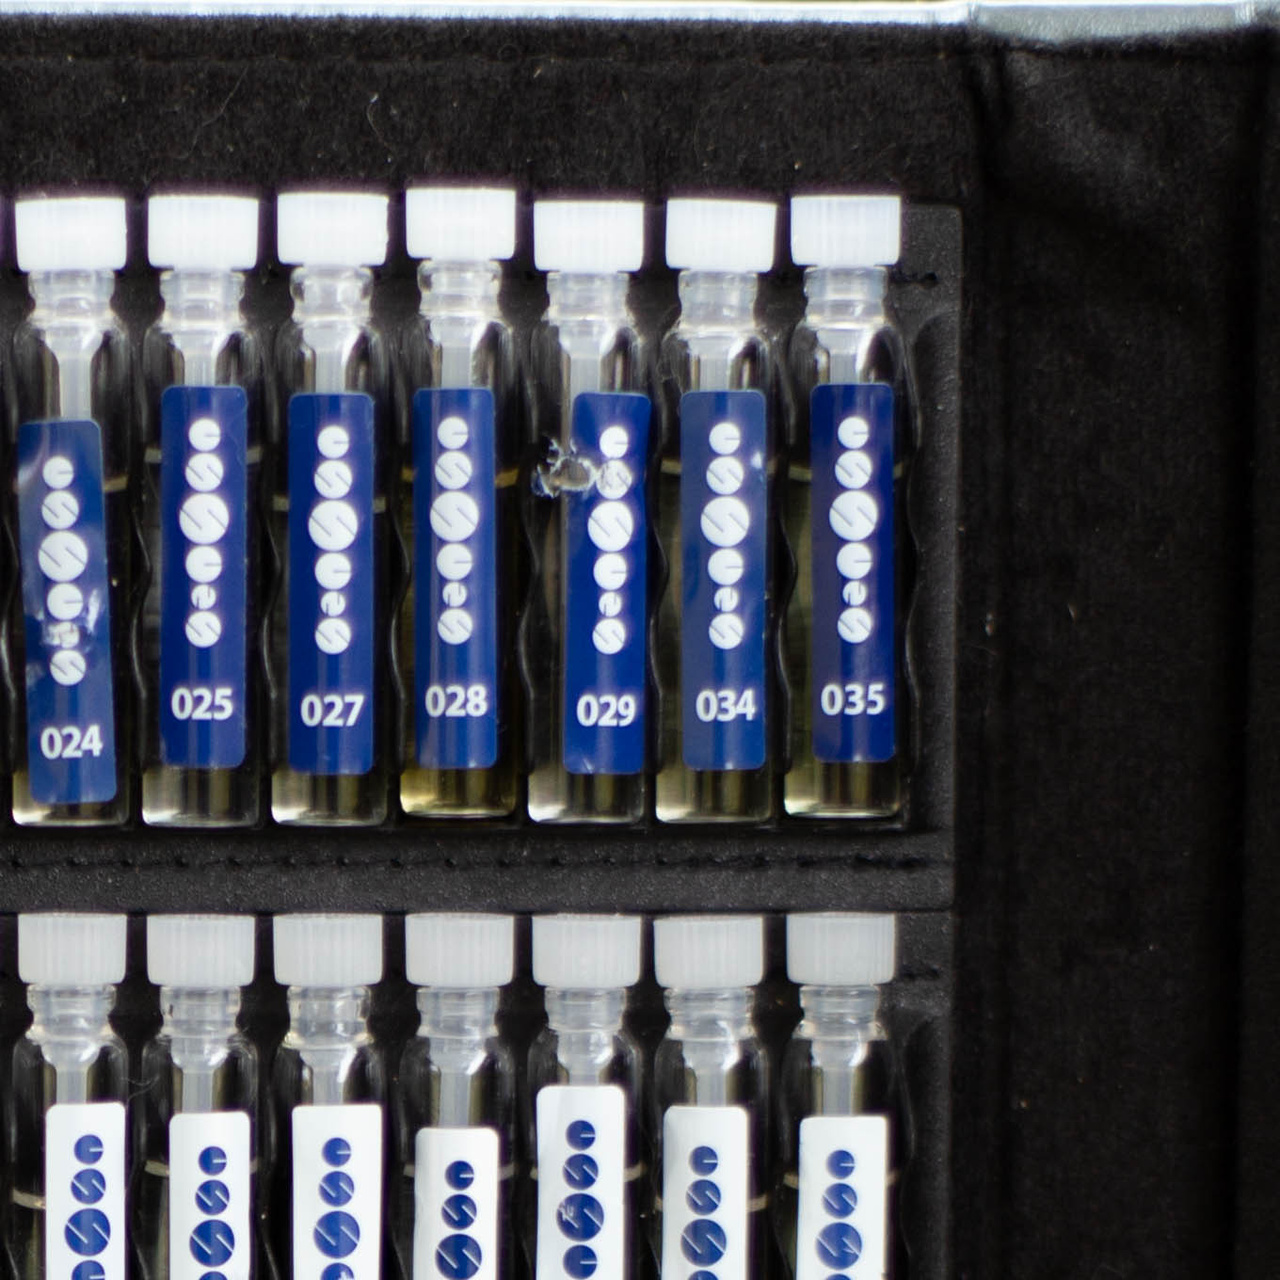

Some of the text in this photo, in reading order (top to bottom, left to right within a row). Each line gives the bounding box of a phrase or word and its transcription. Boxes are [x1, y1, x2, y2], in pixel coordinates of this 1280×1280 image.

[171, 686, 234, 721] 025
[301, 693, 365, 727] 027
[425, 683, 488, 717] 028
[576, 693, 637, 727] 029
[696, 688, 757, 722] 034
[821, 682, 885, 716] 035
[40, 723, 104, 759] 024
